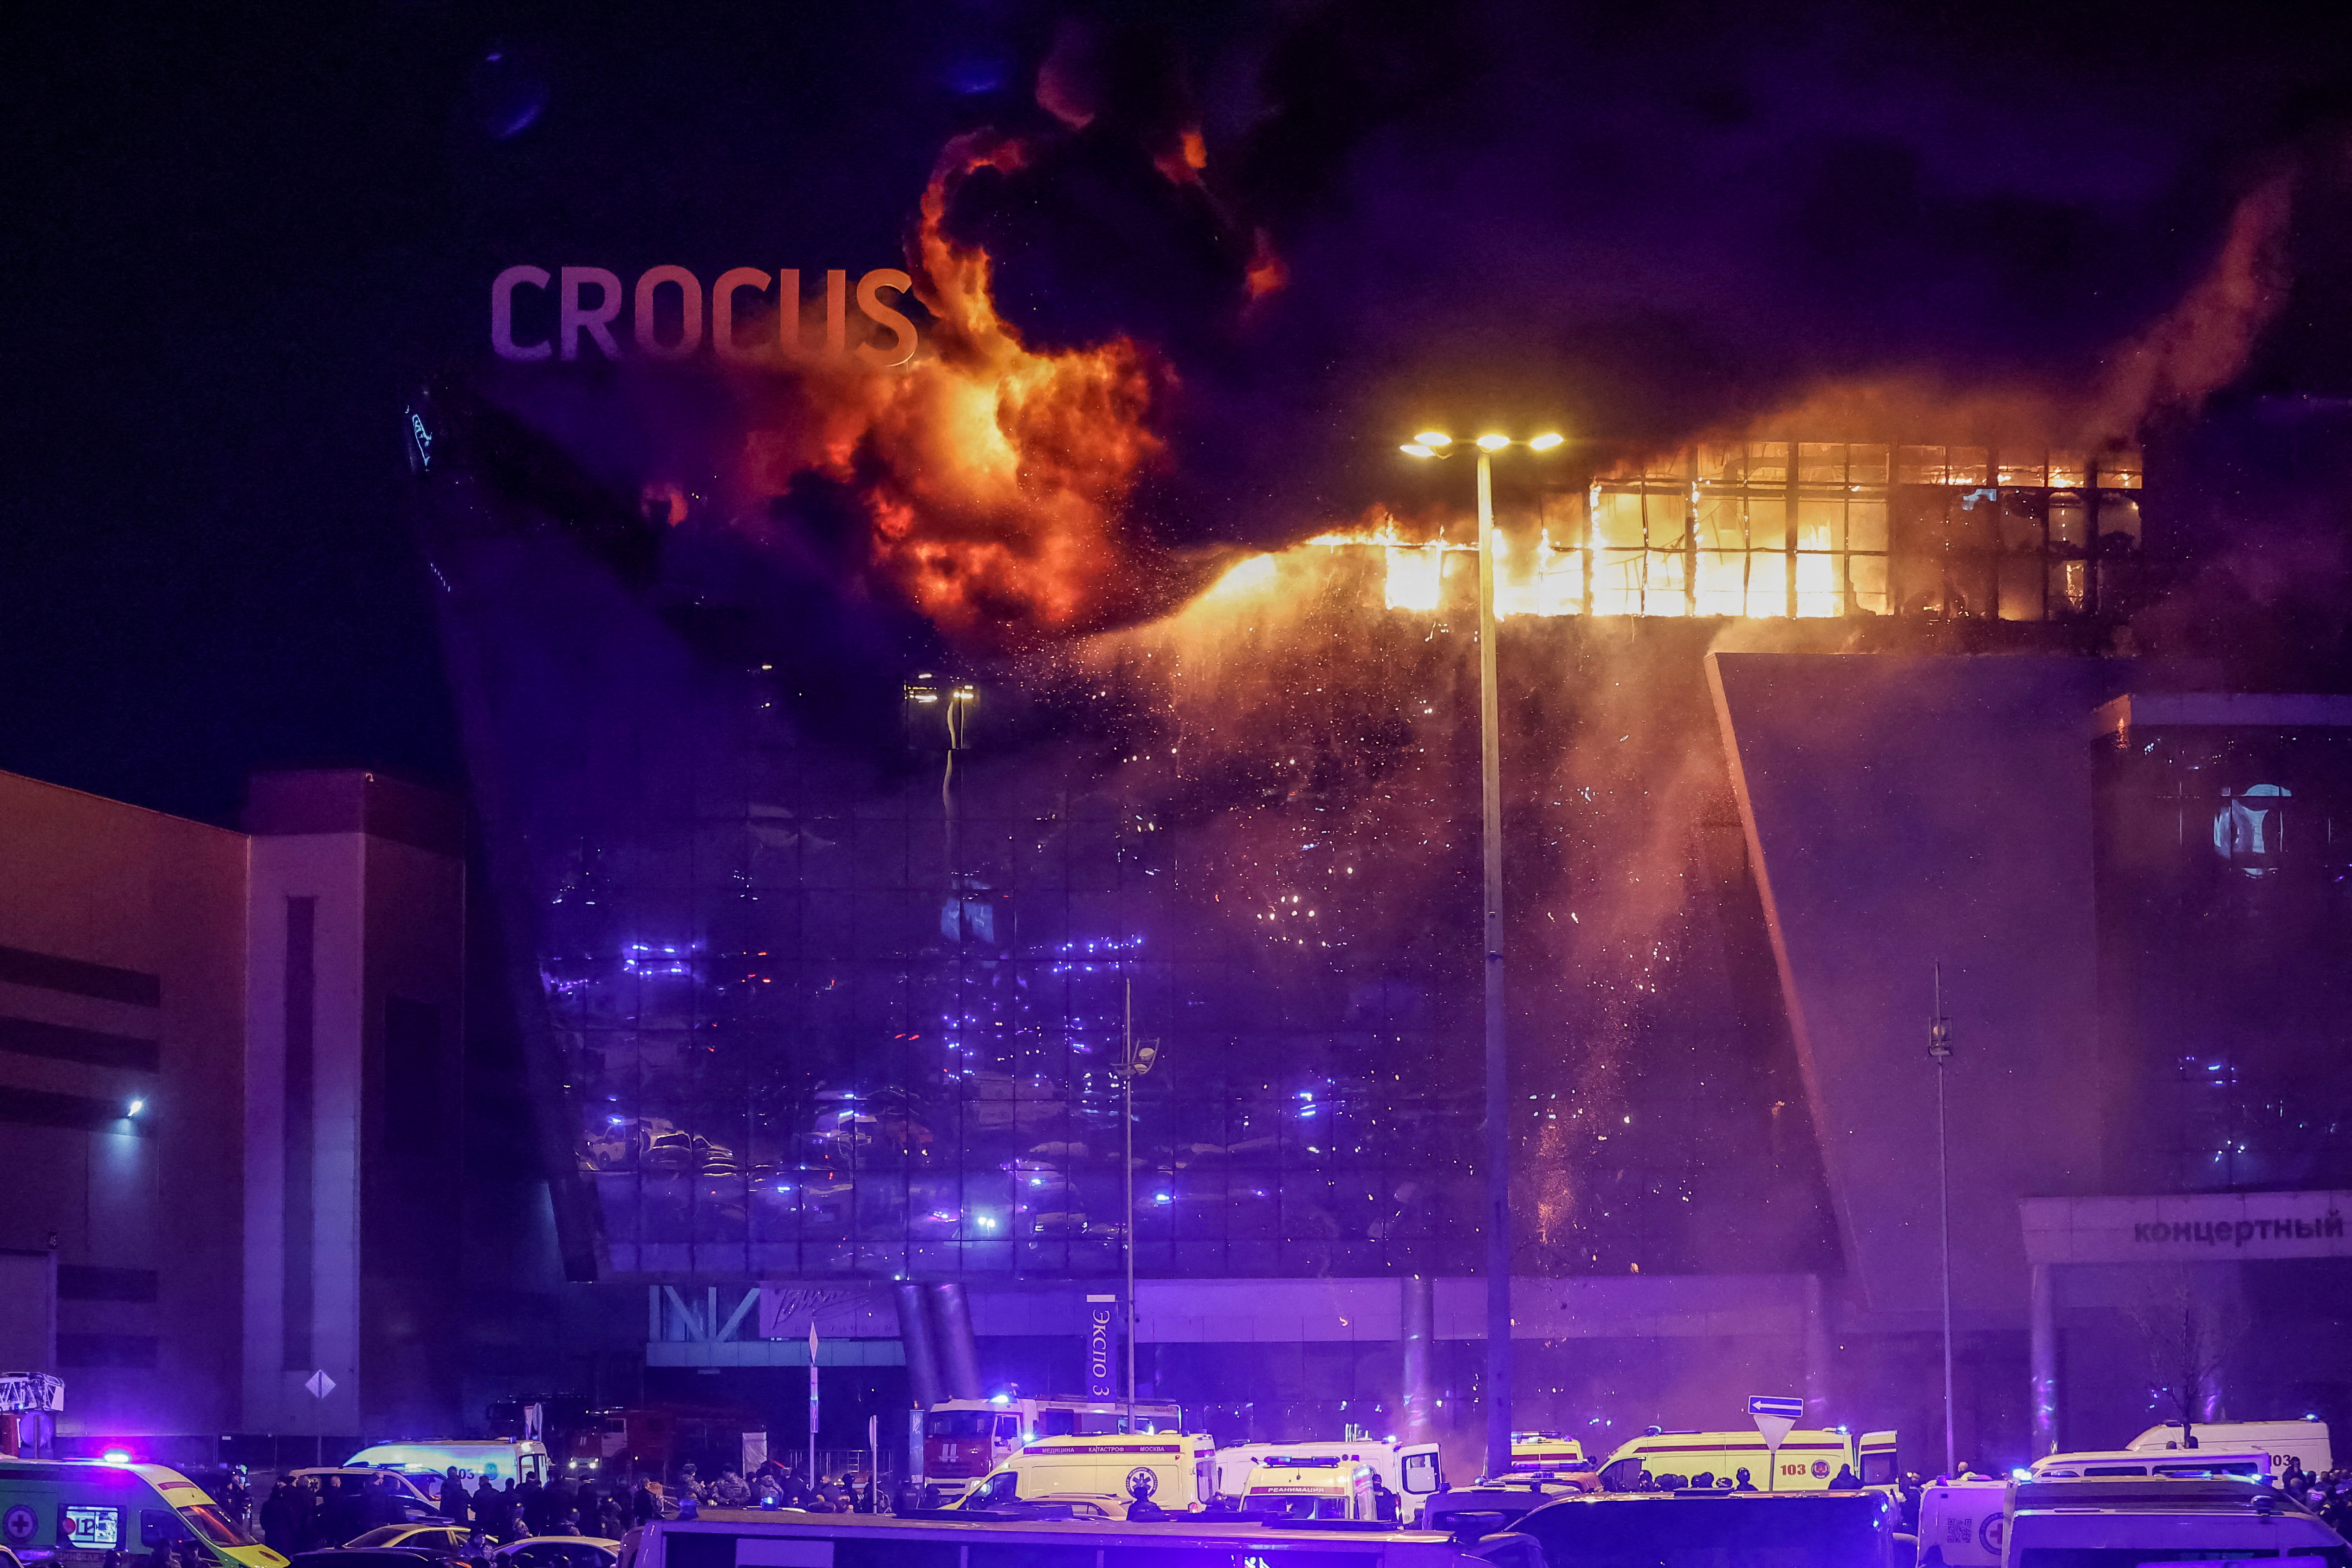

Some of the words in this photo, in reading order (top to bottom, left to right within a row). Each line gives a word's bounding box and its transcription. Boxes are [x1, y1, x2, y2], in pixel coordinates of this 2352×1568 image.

[492, 265, 918, 367] CROCUS
[2135, 1209, 2343, 1247] концертный
[1092, 1385, 1110, 1396] 3
[1007, 1443, 1012, 1452] 4
[1780, 1464, 1806, 1476] 103
